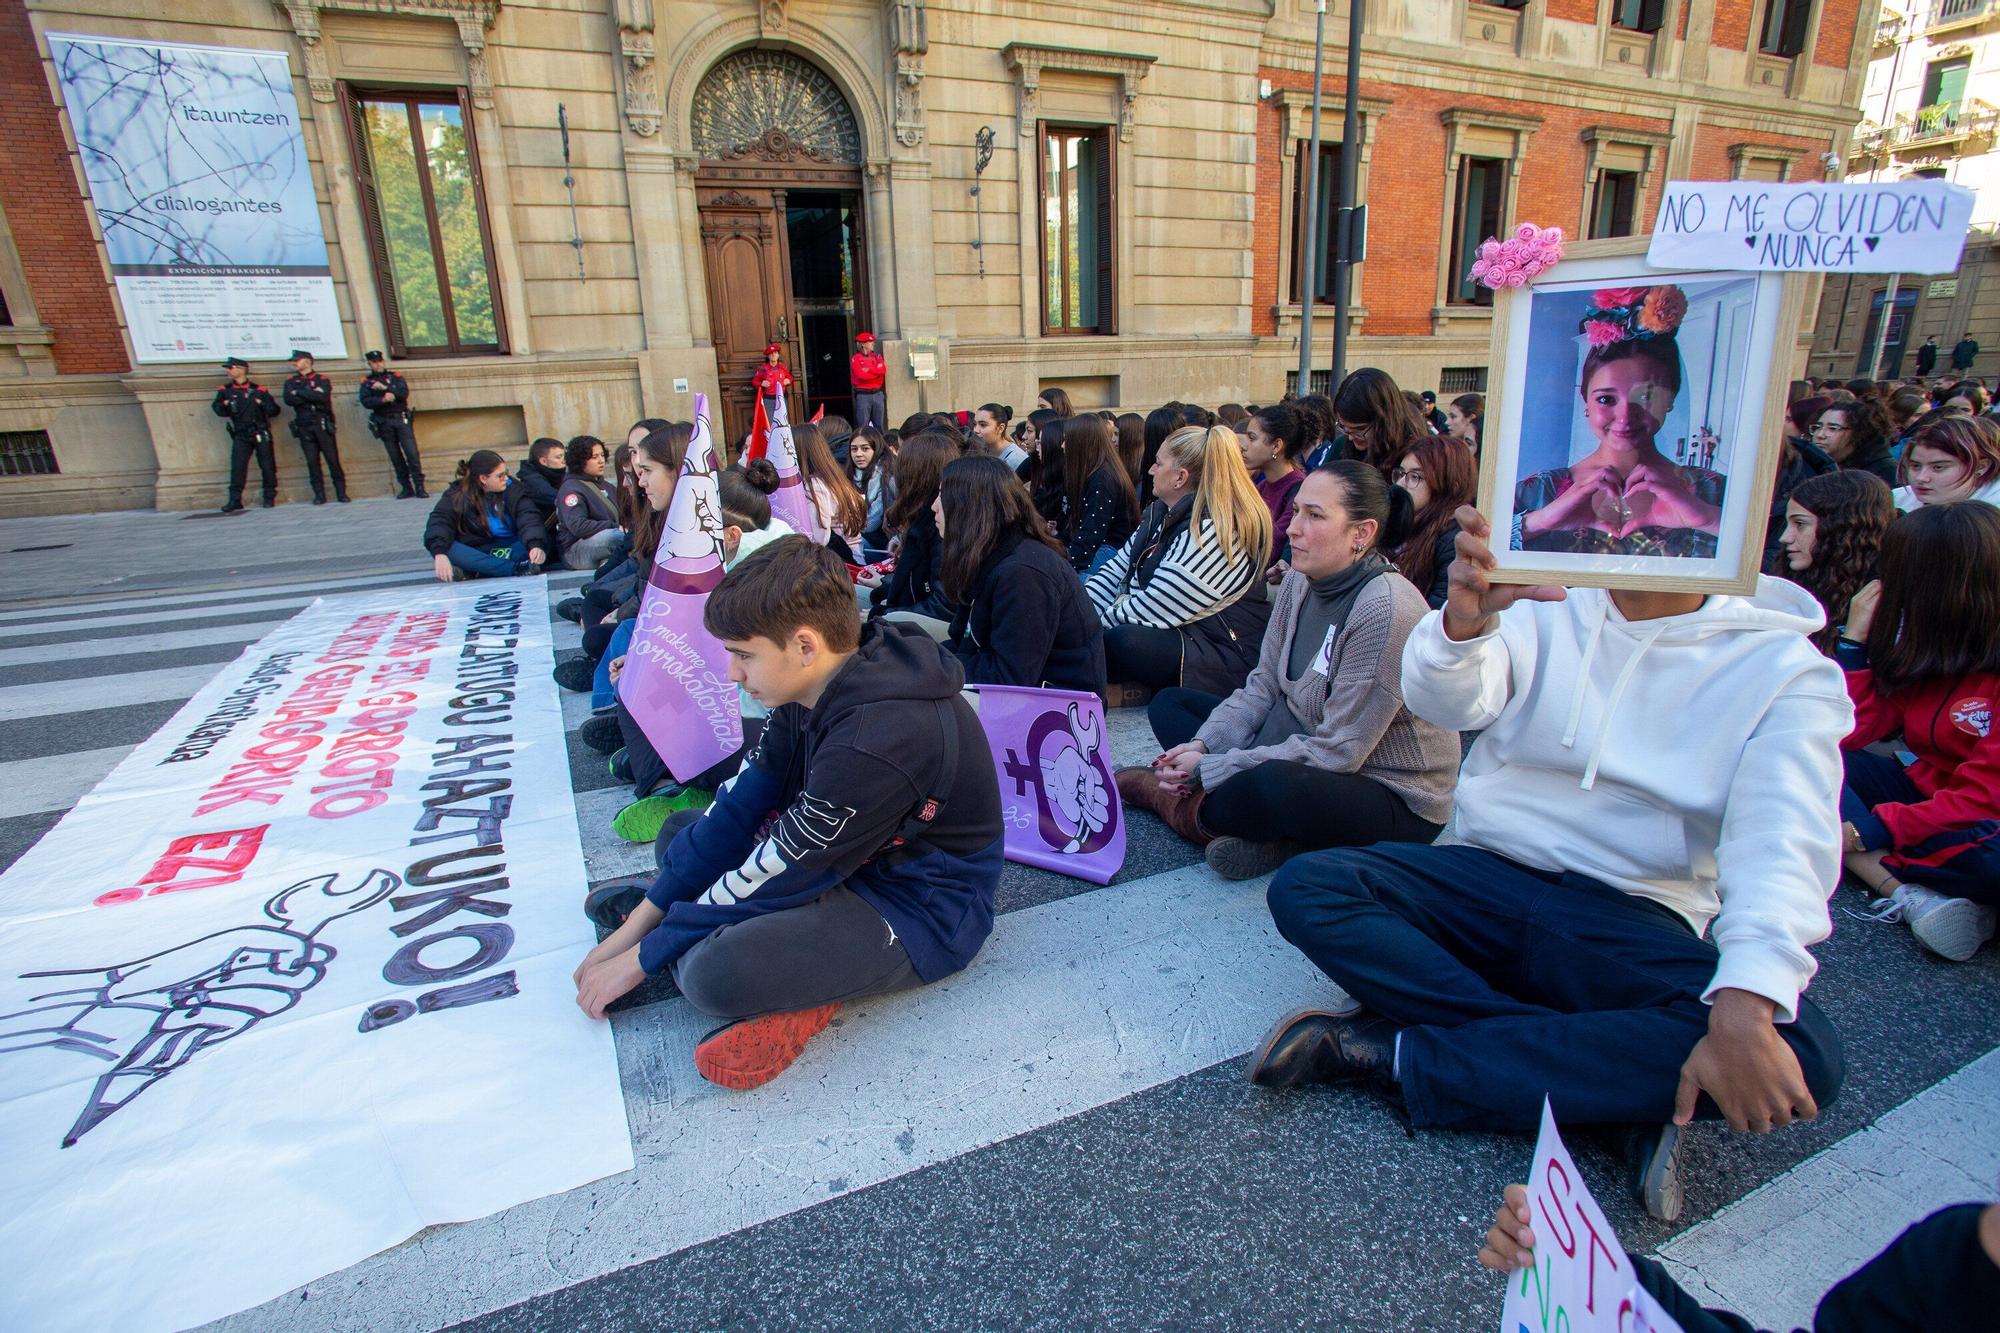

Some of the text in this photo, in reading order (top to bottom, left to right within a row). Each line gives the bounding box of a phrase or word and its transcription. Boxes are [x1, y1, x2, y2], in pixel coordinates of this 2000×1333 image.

[182, 105, 290, 126] itauntzen
[155, 195, 282, 216] dialogantes
[1661, 192, 1947, 235] NO ME OLVIDEN
[1759, 233, 1860, 269] NUNCA
[442, 638, 519, 727] ZAITUGU
[703, 671, 741, 718] Aske
[191, 663, 366, 818] GEHIAGORIK
[307, 690, 419, 820] GORROTO
[92, 823, 272, 908] EZ!
[357, 732, 521, 1034] AHAZTUKO!
